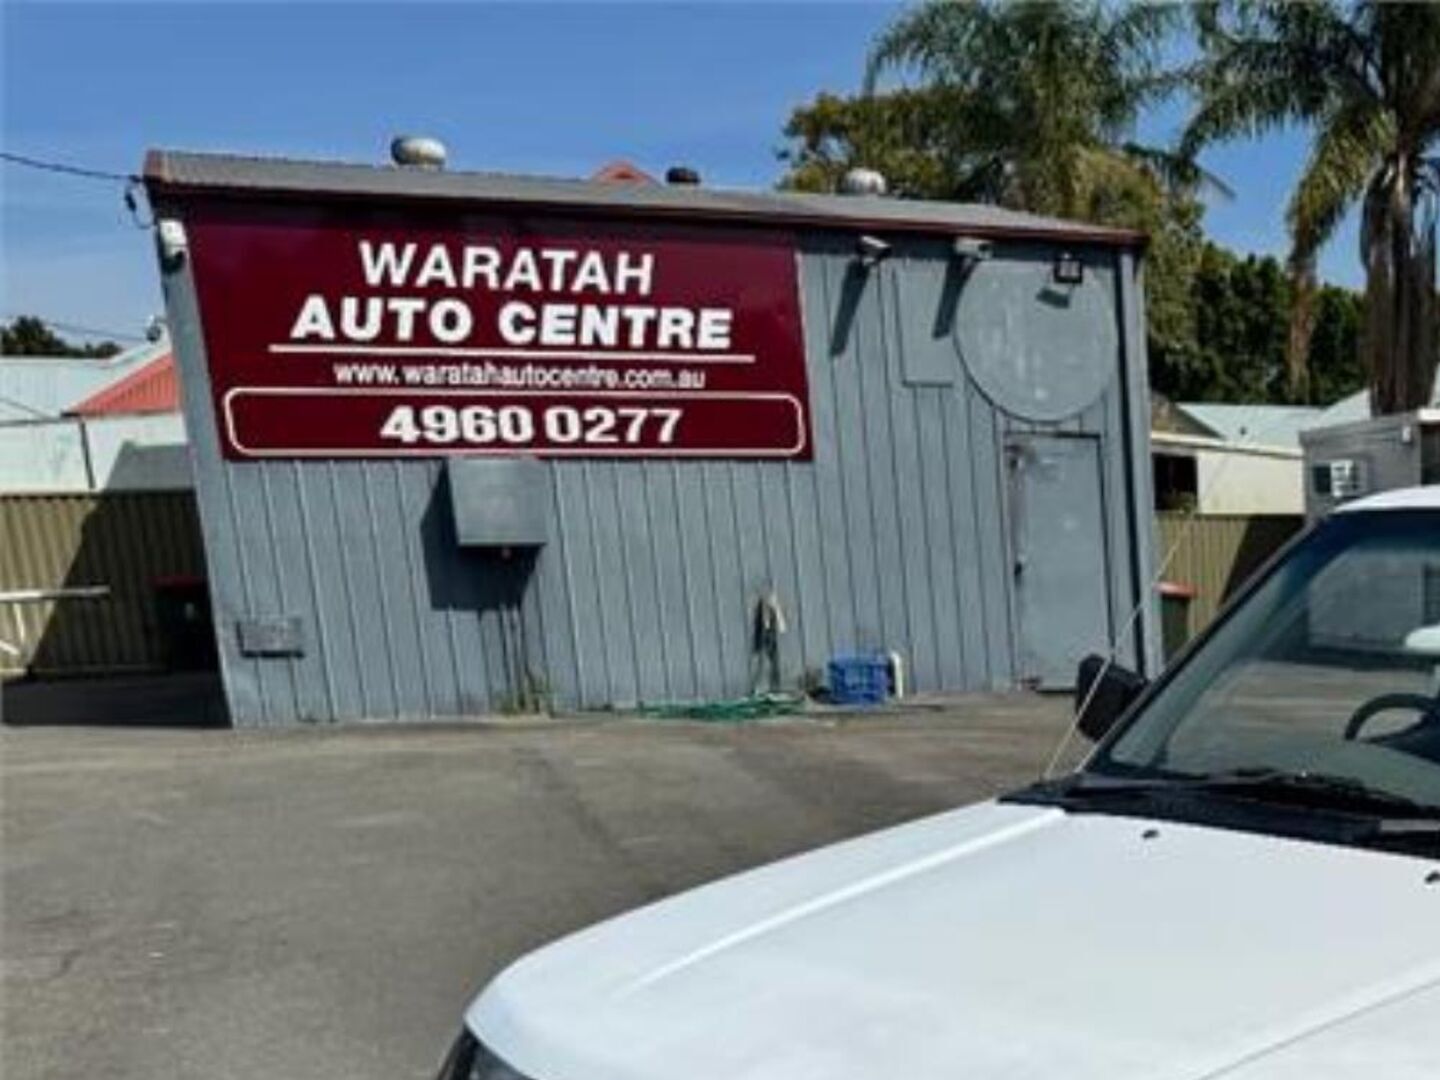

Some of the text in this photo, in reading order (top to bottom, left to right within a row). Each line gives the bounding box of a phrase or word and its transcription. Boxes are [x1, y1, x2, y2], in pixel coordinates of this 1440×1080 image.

[358, 240, 655, 296] WARATAH
[289, 294, 733, 349] AUTO CENTRE
[333, 361, 706, 389] www.waratahautocentre.com.au
[379, 404, 684, 443] 4960 0277
